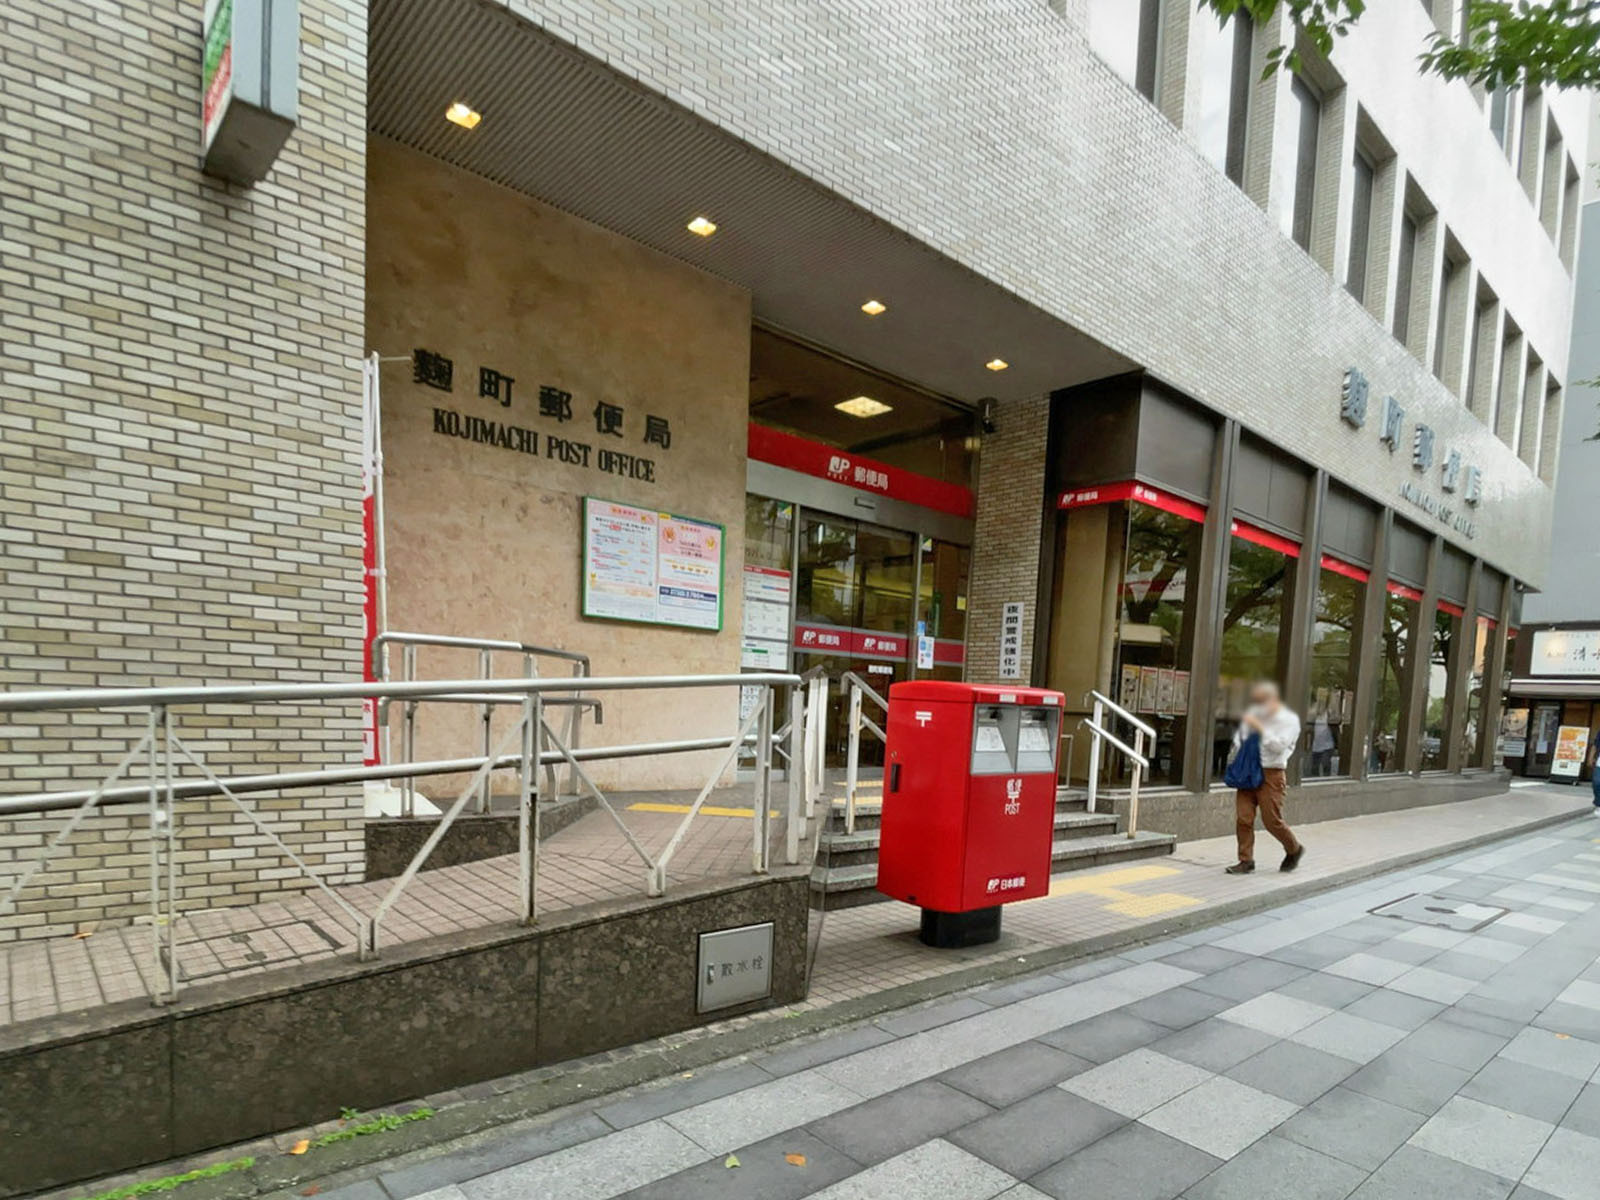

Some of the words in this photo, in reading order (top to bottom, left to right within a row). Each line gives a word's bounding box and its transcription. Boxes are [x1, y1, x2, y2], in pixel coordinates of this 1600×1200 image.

[433, 408, 538, 456] KOJIMACHI
[547, 435, 591, 468] POST
[598, 448, 655, 483] OFFICE
[854, 465, 888, 490] 郵便局
